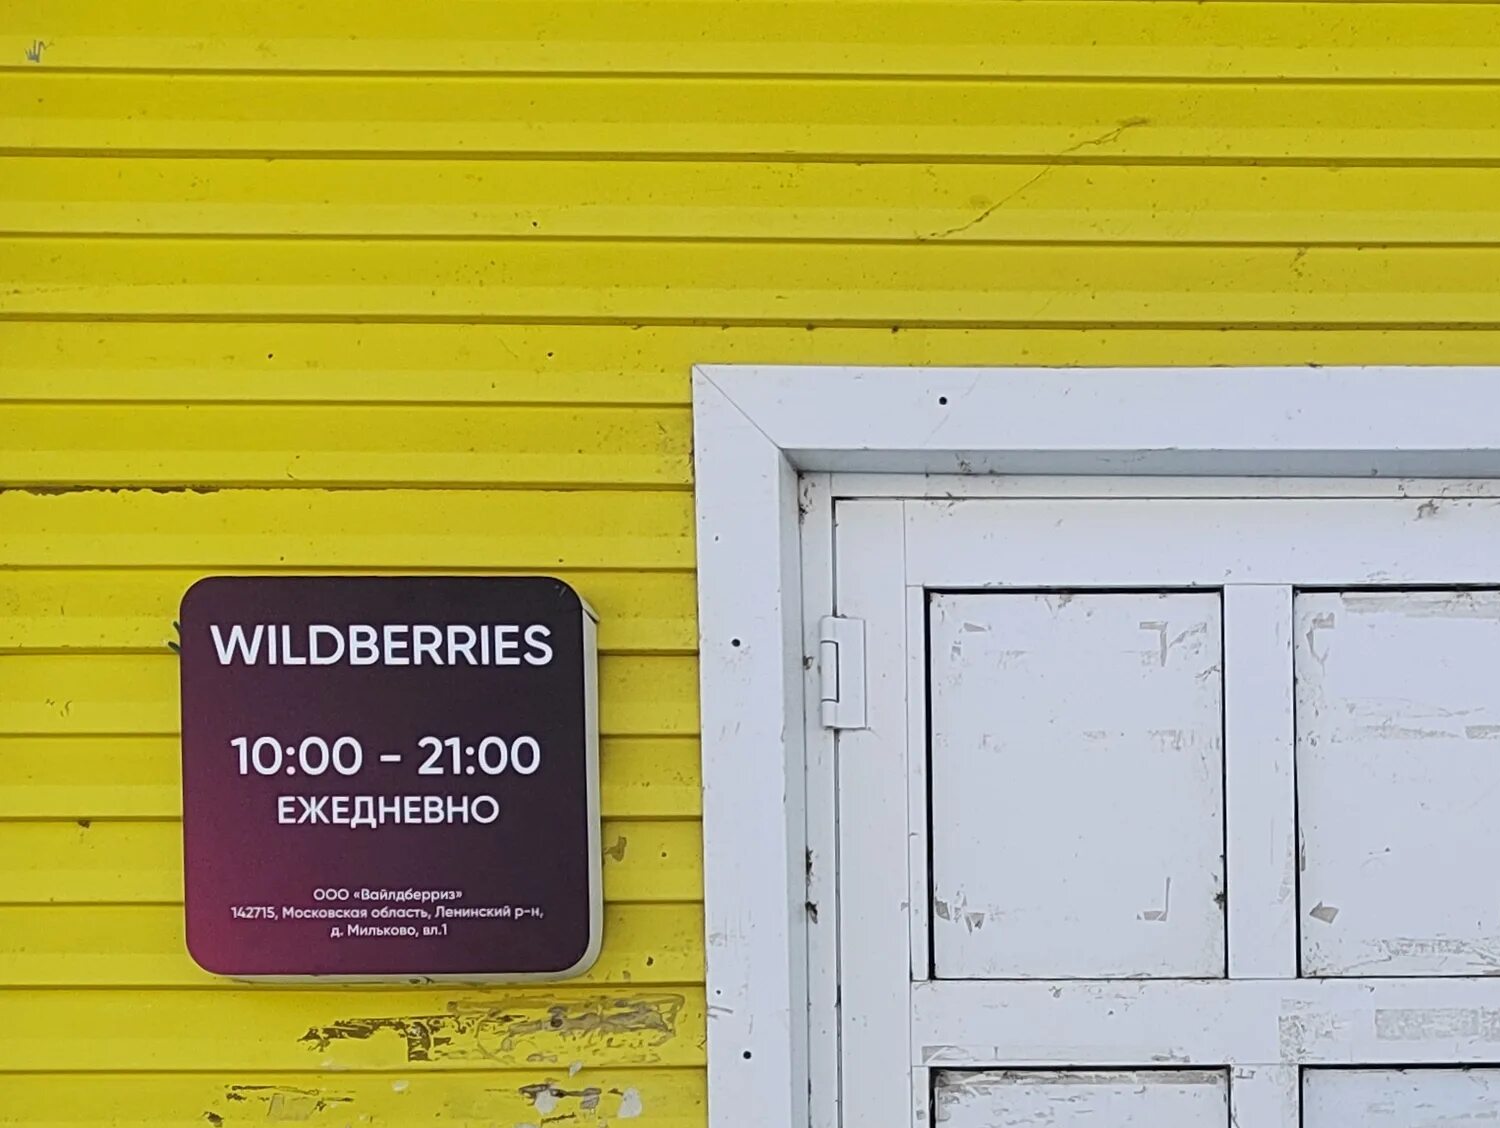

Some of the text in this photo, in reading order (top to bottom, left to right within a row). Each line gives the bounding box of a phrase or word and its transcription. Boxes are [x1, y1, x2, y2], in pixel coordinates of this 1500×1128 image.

[209, 624, 553, 666] WILDBERRIES
[230, 736, 363, 776] 10:00
[417, 735, 541, 776] 21:00
[277, 795, 500, 829] ЕЖЕДНЕВНО
[313, 888, 463, 903] ООО «Вайлдберриз»
[230, 905, 544, 920] 142715, Московская область, Ленинский р-н,
[330, 923, 448, 938] д. Мильково, вл.1
